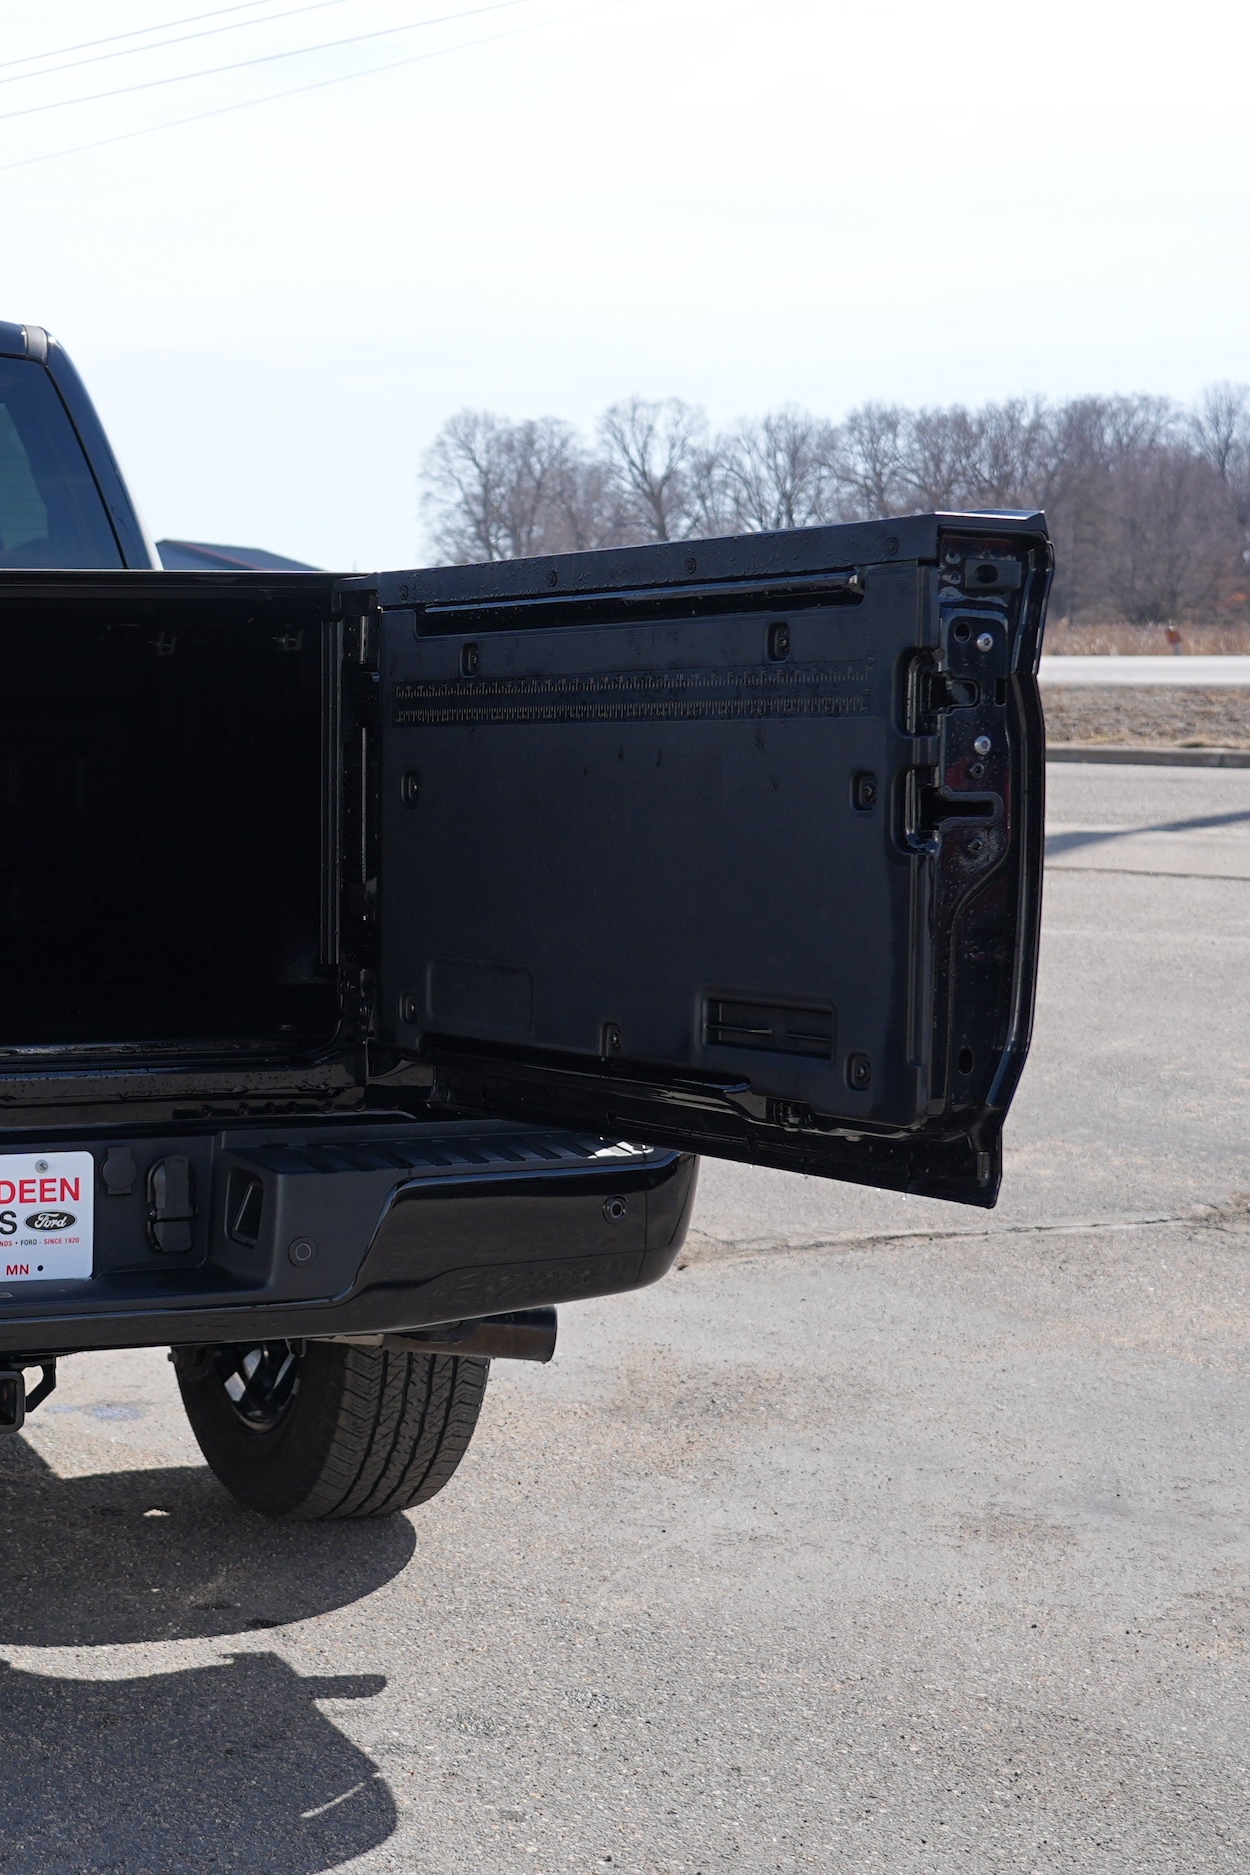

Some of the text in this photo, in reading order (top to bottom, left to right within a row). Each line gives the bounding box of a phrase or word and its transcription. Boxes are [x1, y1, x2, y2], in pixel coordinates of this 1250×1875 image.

[34, 1213, 68, 1229] Ford
[20, 1238, 38, 1246] FORD
[43, 1237, 63, 1245] SINCE
[64, 1236, 80, 1244] 1920
[6, 1264, 30, 1276] MN
